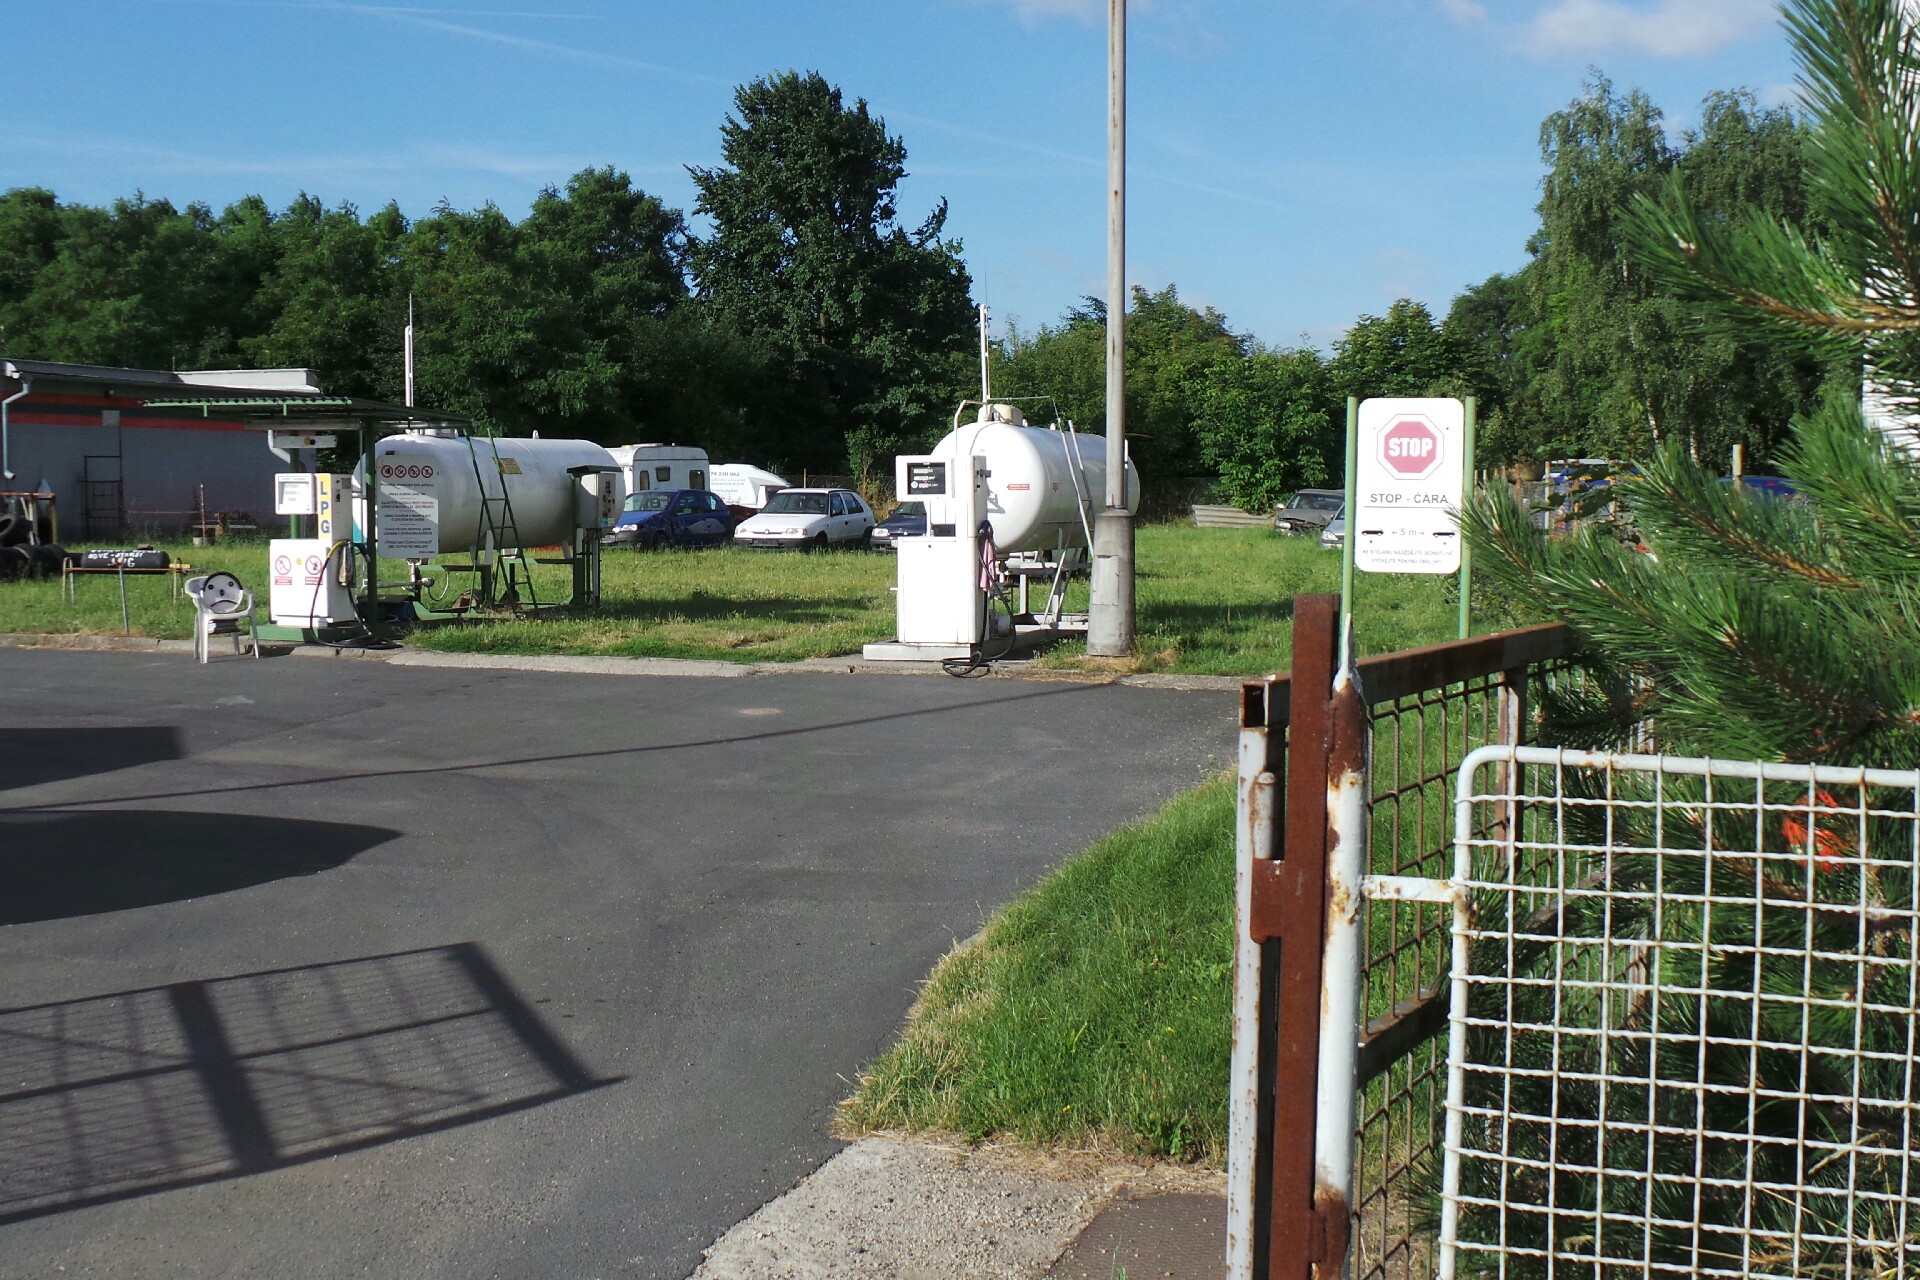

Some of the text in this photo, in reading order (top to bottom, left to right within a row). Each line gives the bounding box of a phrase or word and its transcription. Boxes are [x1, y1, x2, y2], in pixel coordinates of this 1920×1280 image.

[1388, 437, 1433, 457] STOP
[1370, 493, 1402, 503] STOP
[1413, 492, 1449, 504] ČÁRA
[1400, 528, 1405, 536] 5
